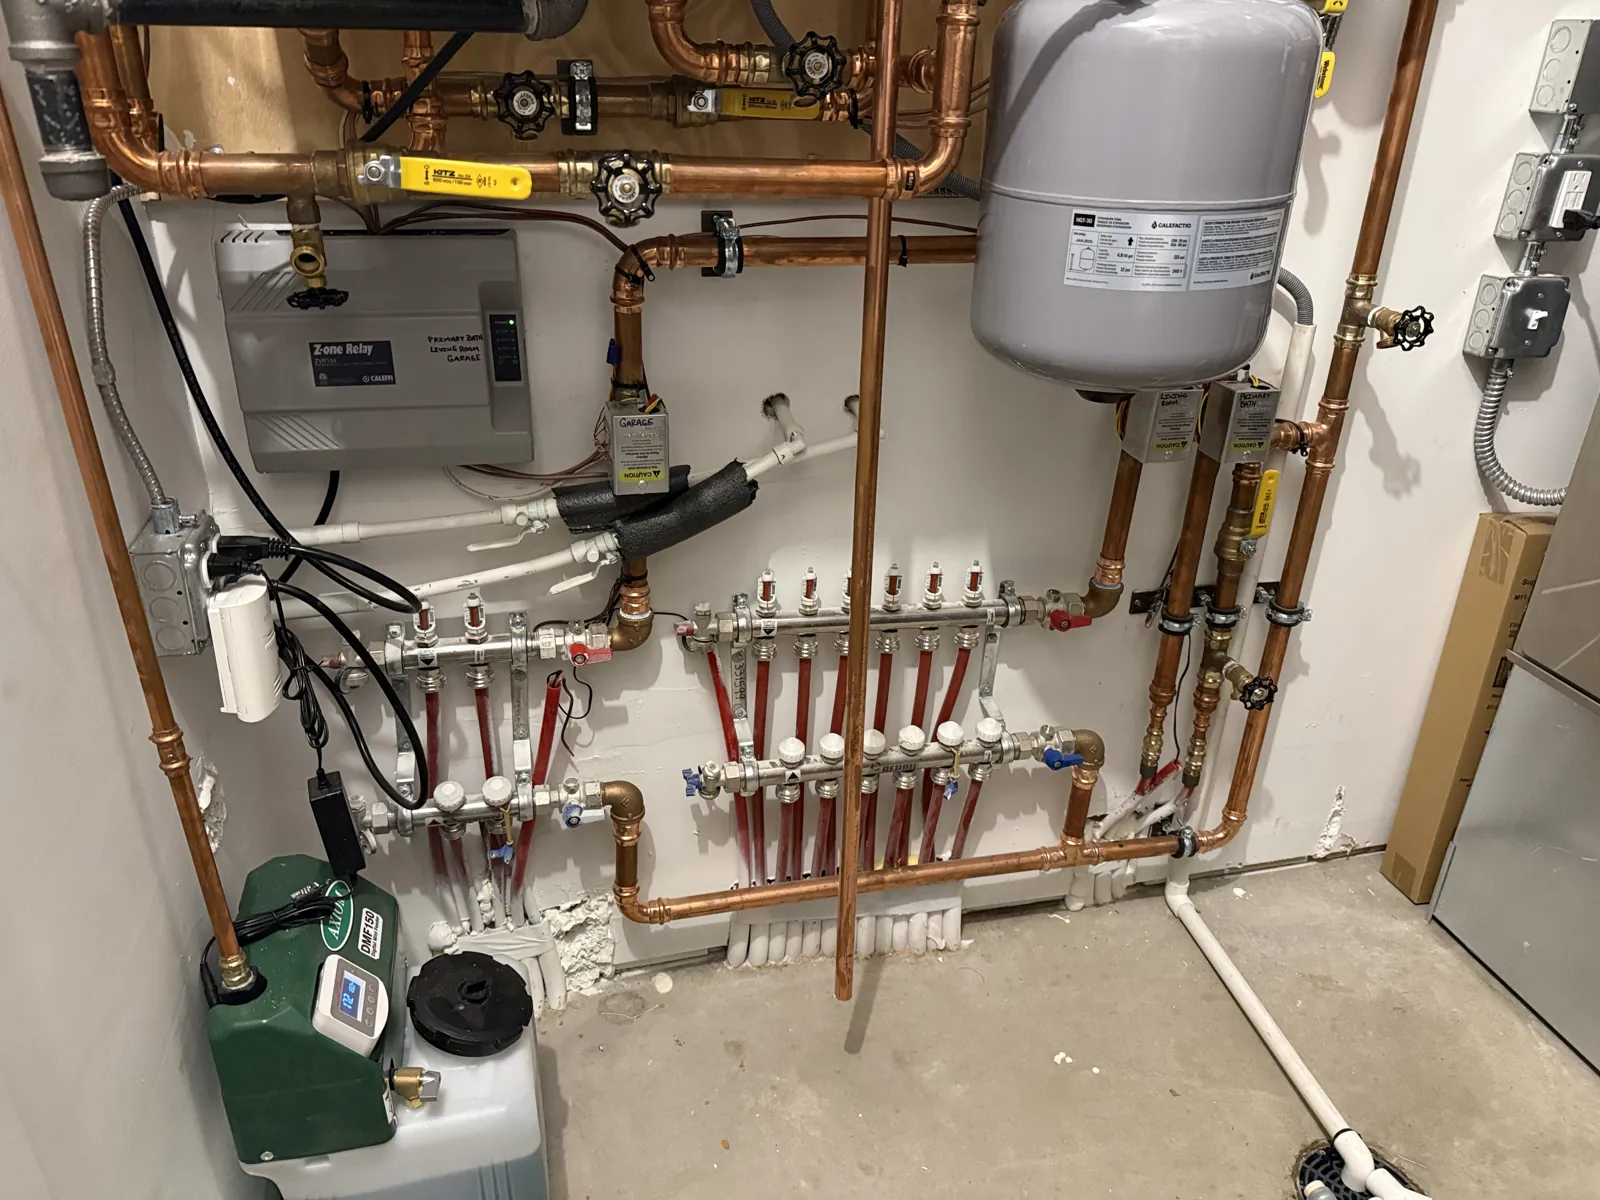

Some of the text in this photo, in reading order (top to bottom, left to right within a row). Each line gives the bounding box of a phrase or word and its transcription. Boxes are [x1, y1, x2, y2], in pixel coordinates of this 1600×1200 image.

[433, 169, 456, 178] KITZ
[427, 333, 484, 343] PRIMARY BATH
[313, 343, 374, 356] Z-one Relay
[430, 345, 458, 353] LIVING
[447, 354, 482, 363] GARAGE
[370, 374, 394, 382] CALEFFI
[1239, 392, 1271, 401] PRIMARY
[1239, 400, 1257, 409] BATH
[619, 417, 654, 428] GARAGE
[624, 471, 652, 479] CAUTION
[882, 763, 917, 773] REHAU
[327, 888, 346, 941] AXIOM
[360, 910, 375, 954] DMF150
